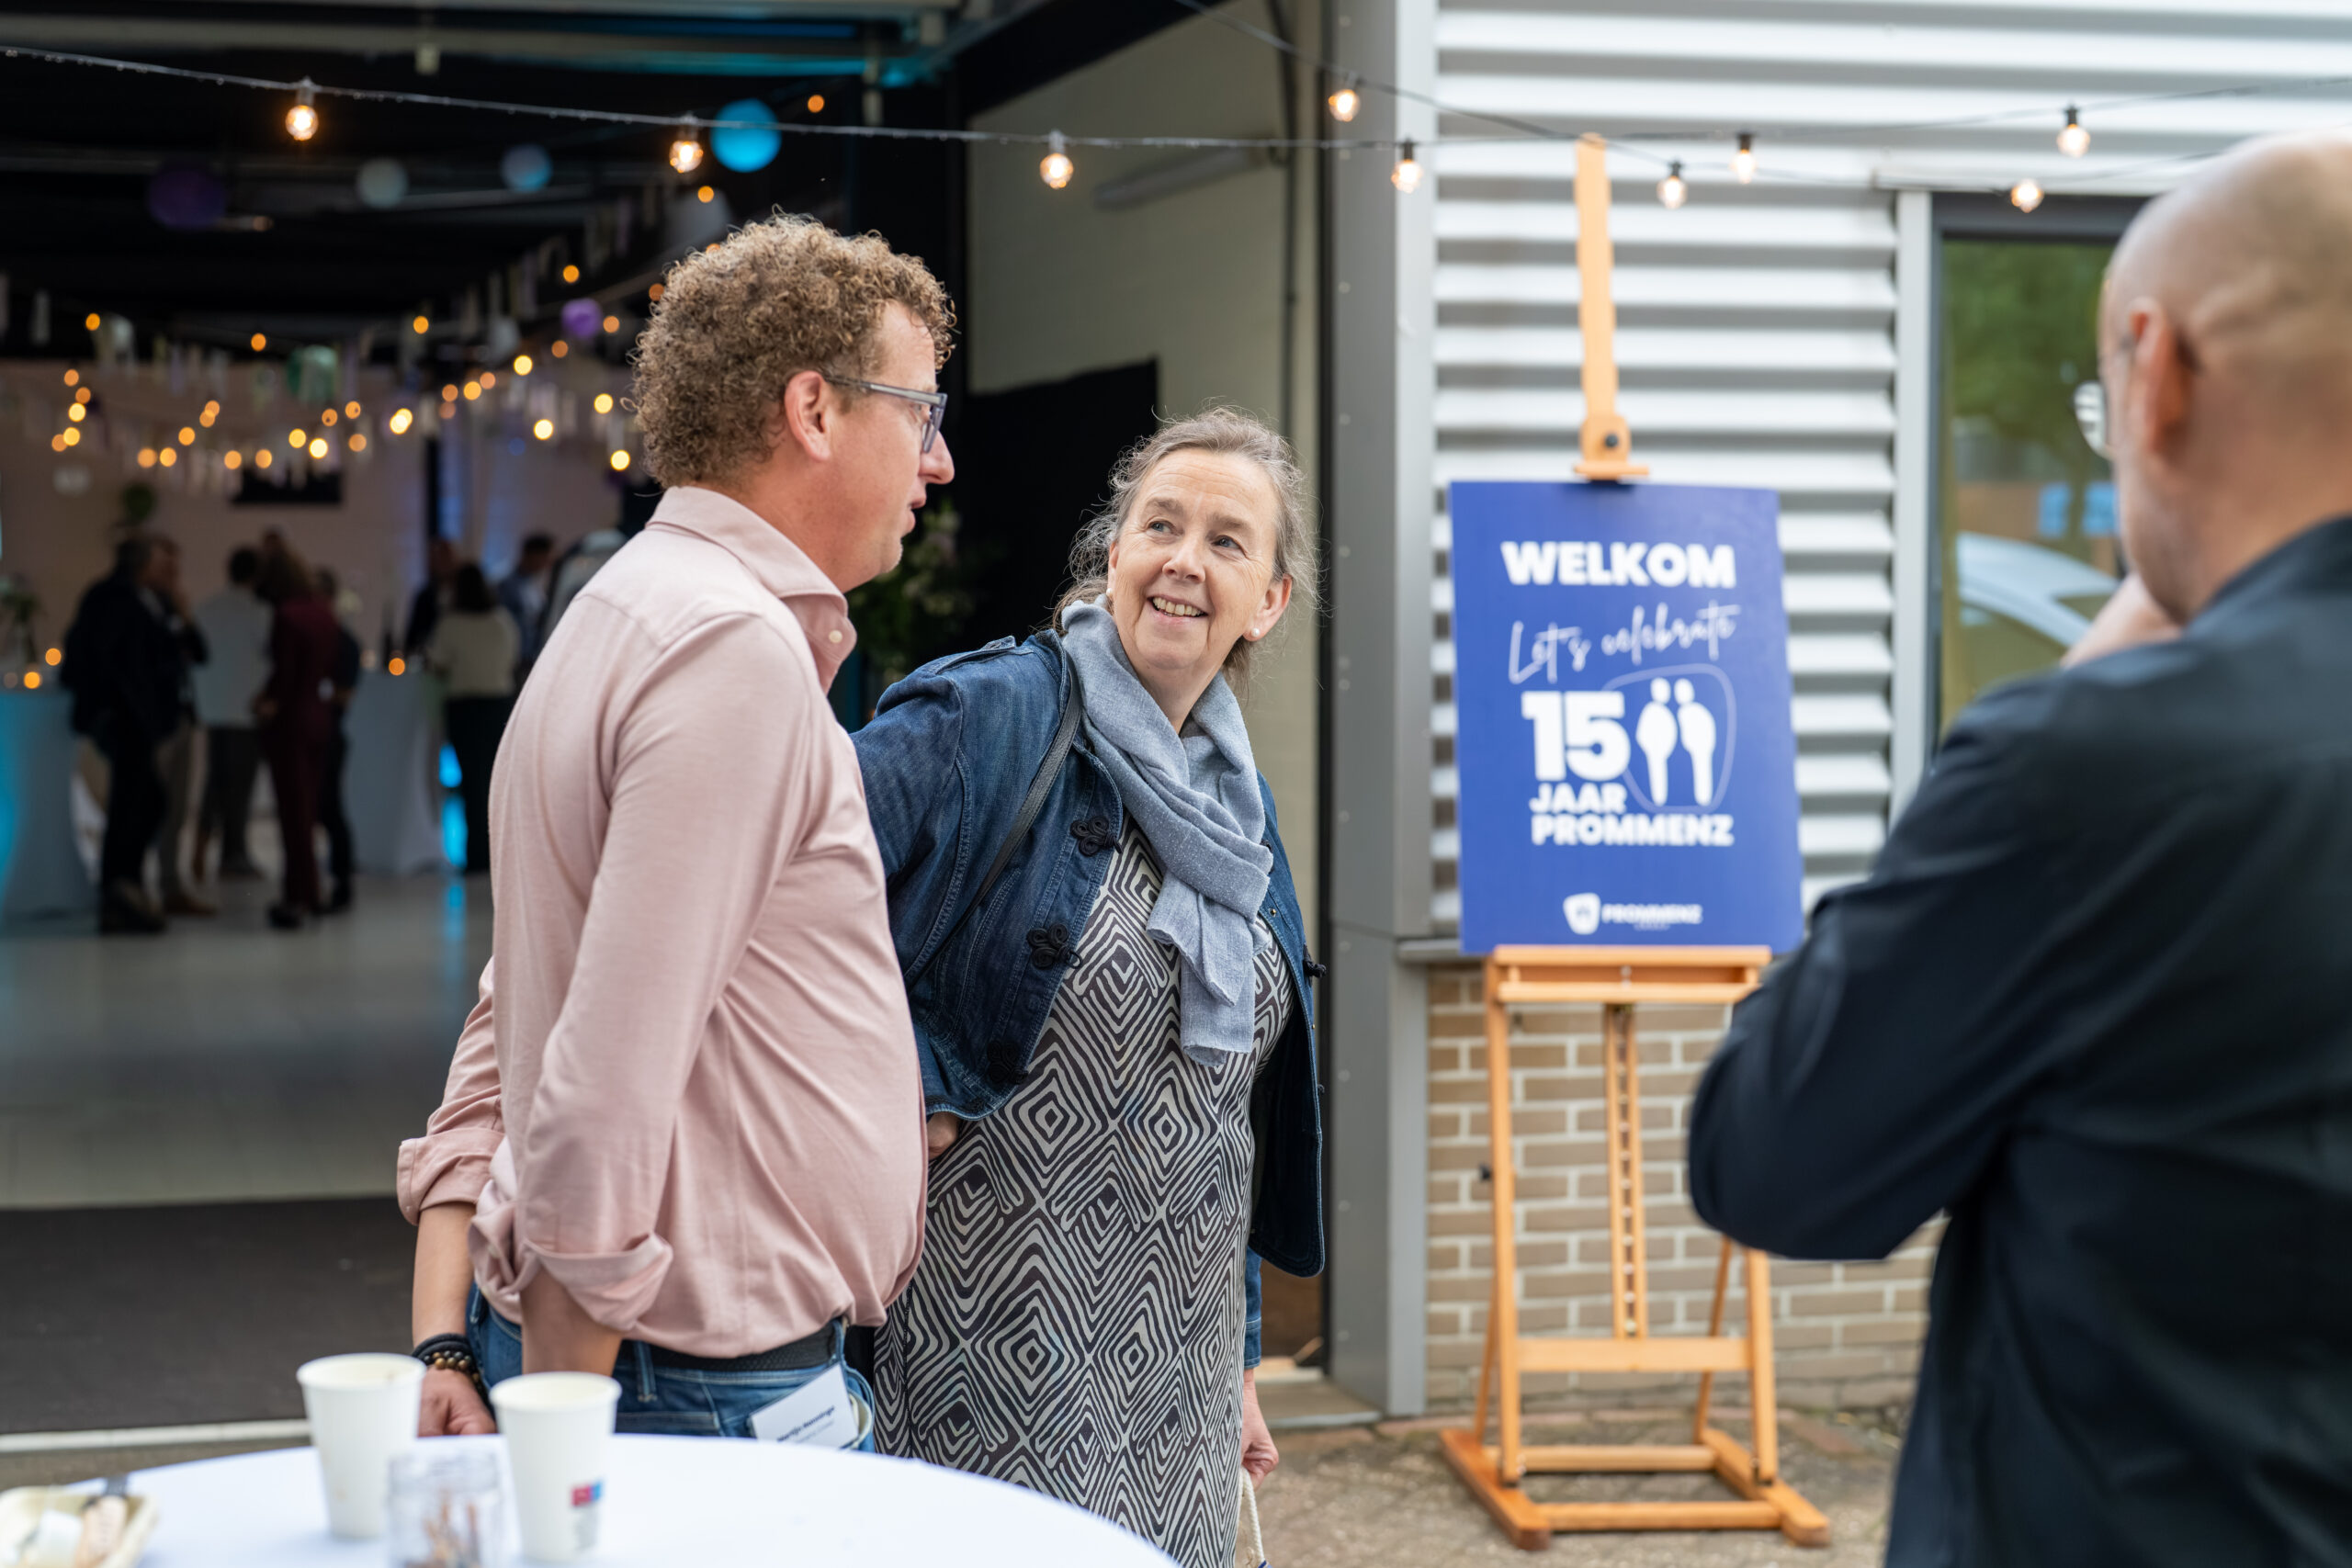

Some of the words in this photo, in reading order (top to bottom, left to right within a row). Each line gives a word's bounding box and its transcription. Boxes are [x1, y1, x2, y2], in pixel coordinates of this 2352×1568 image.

[1500, 541, 1736, 589] WELKOM
[1509, 621, 1591, 684] Let's
[1601, 600, 1741, 665] celebrate
[1521, 691, 1631, 781] 15
[1529, 783, 1627, 814] JAAR
[1532, 814, 1734, 846] PROMMENZ
[1601, 904, 1703, 924] PROMMENZ
